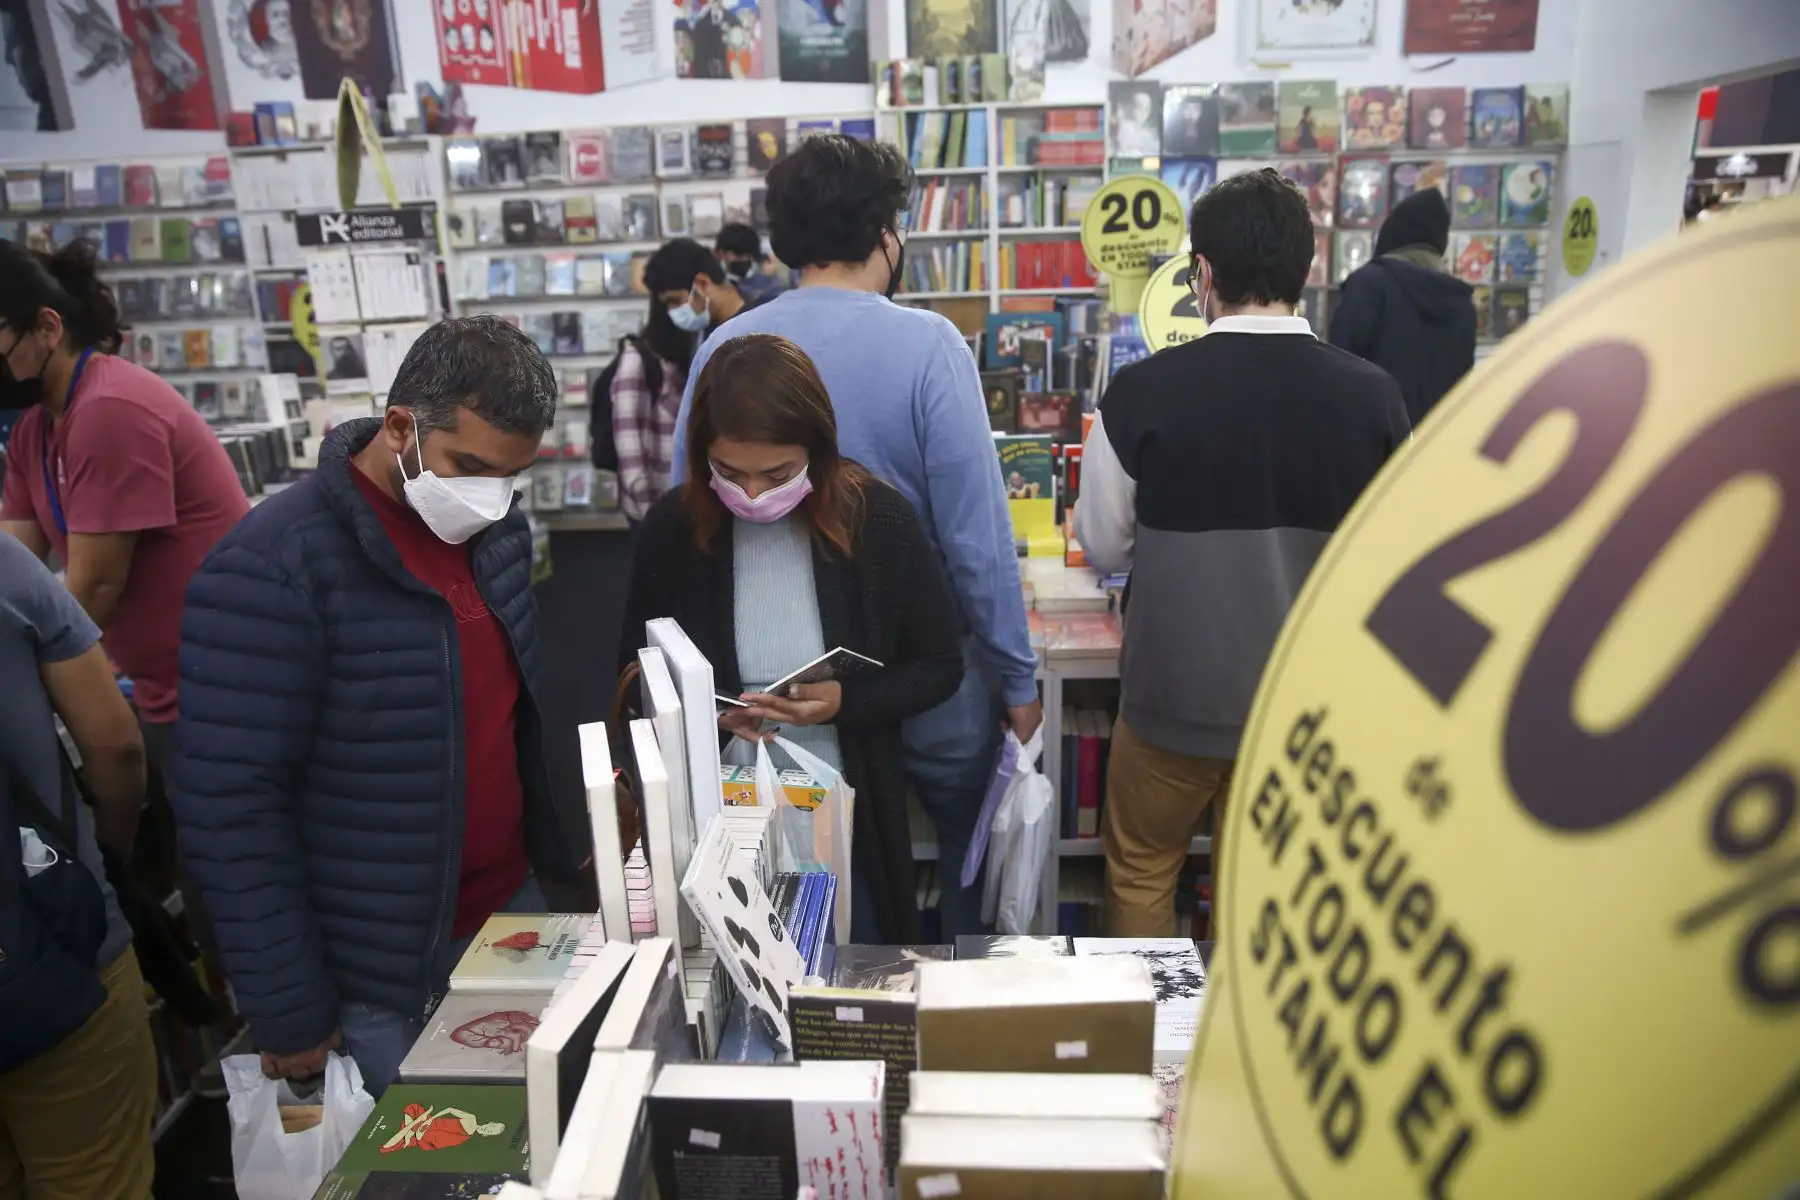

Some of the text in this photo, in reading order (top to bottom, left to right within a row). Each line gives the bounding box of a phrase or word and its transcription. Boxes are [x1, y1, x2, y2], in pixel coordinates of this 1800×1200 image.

[351, 215, 396, 226] Alianza
[351, 226, 404, 240] editorial
[1101, 237, 1169, 253] descuento
[1117, 260, 1147, 271] STAN
[1406, 755, 1454, 824] de
[1285, 705, 1545, 1120] descuento
[1250, 767, 1474, 1200] EN TODO EL
[1250, 897, 1364, 1161] STAND
